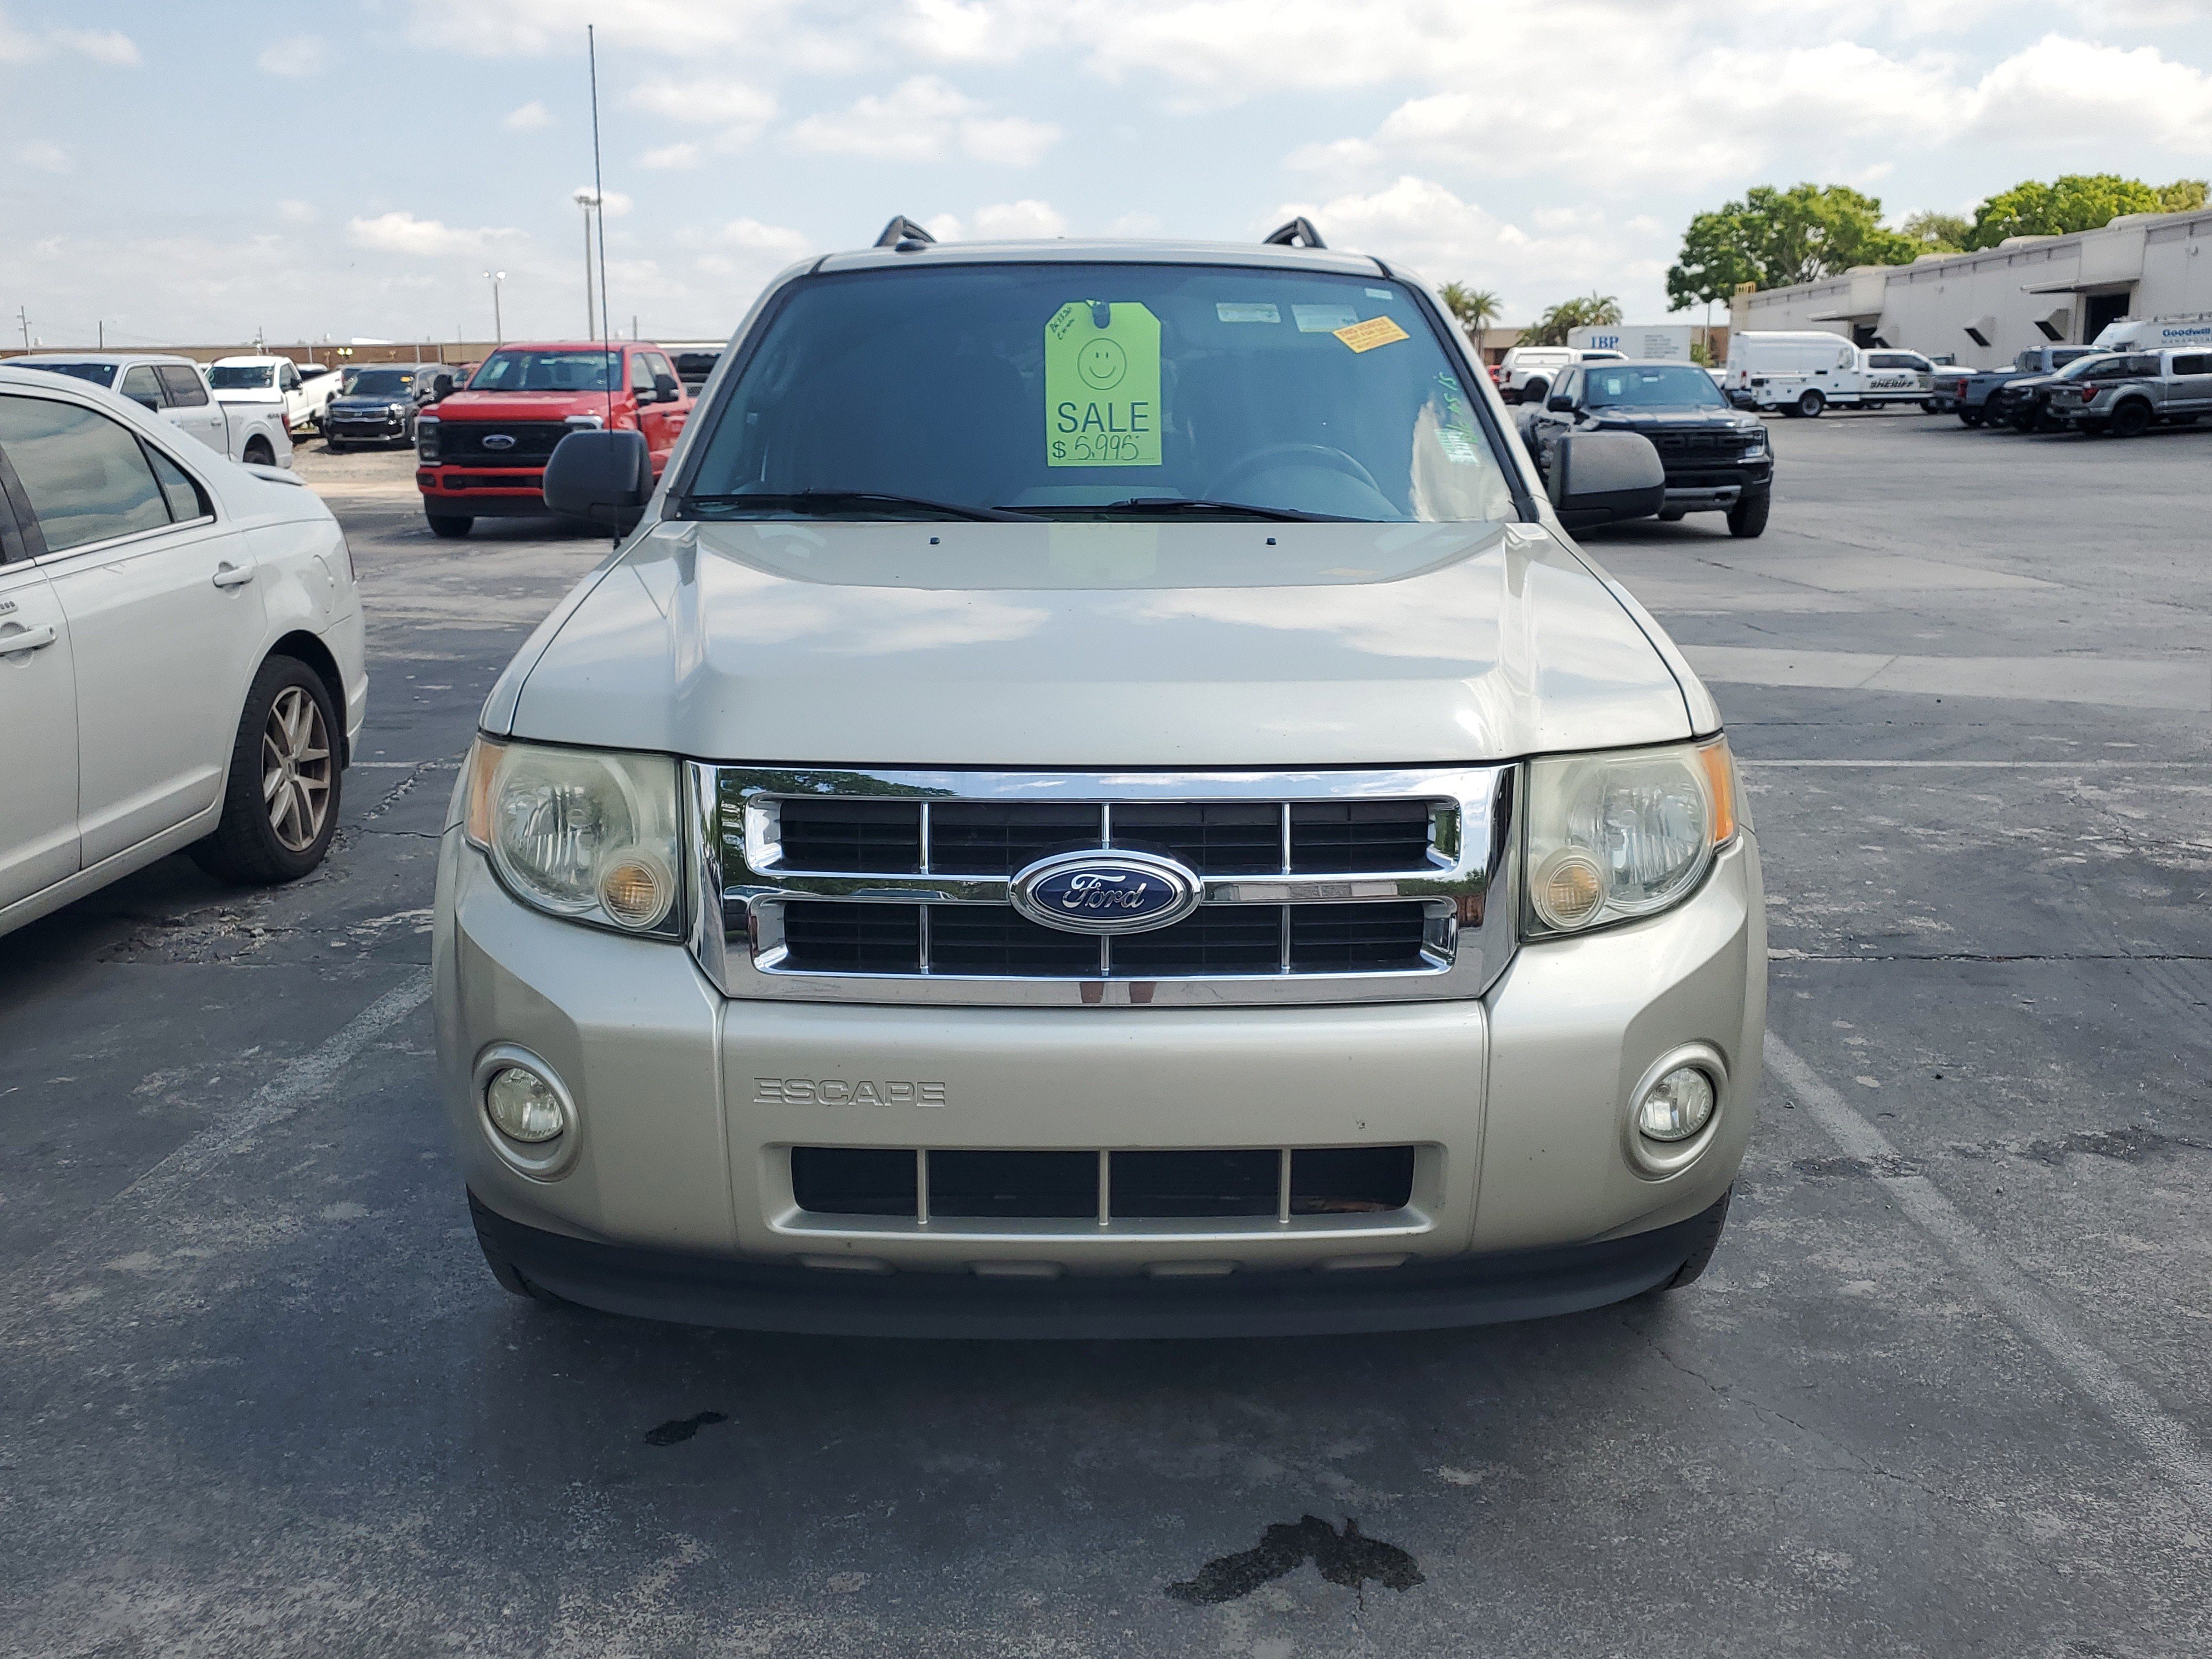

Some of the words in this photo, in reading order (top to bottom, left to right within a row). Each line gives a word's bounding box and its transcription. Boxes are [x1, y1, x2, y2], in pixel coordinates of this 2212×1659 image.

[2162, 328, 2210, 336] Goodwill
[1870, 377, 1914, 389] SHERIFF
[1057, 402, 1150, 433] SALE
[1062, 873, 1147, 909] Ford
[753, 1077, 945, 1107] ESCAPE
